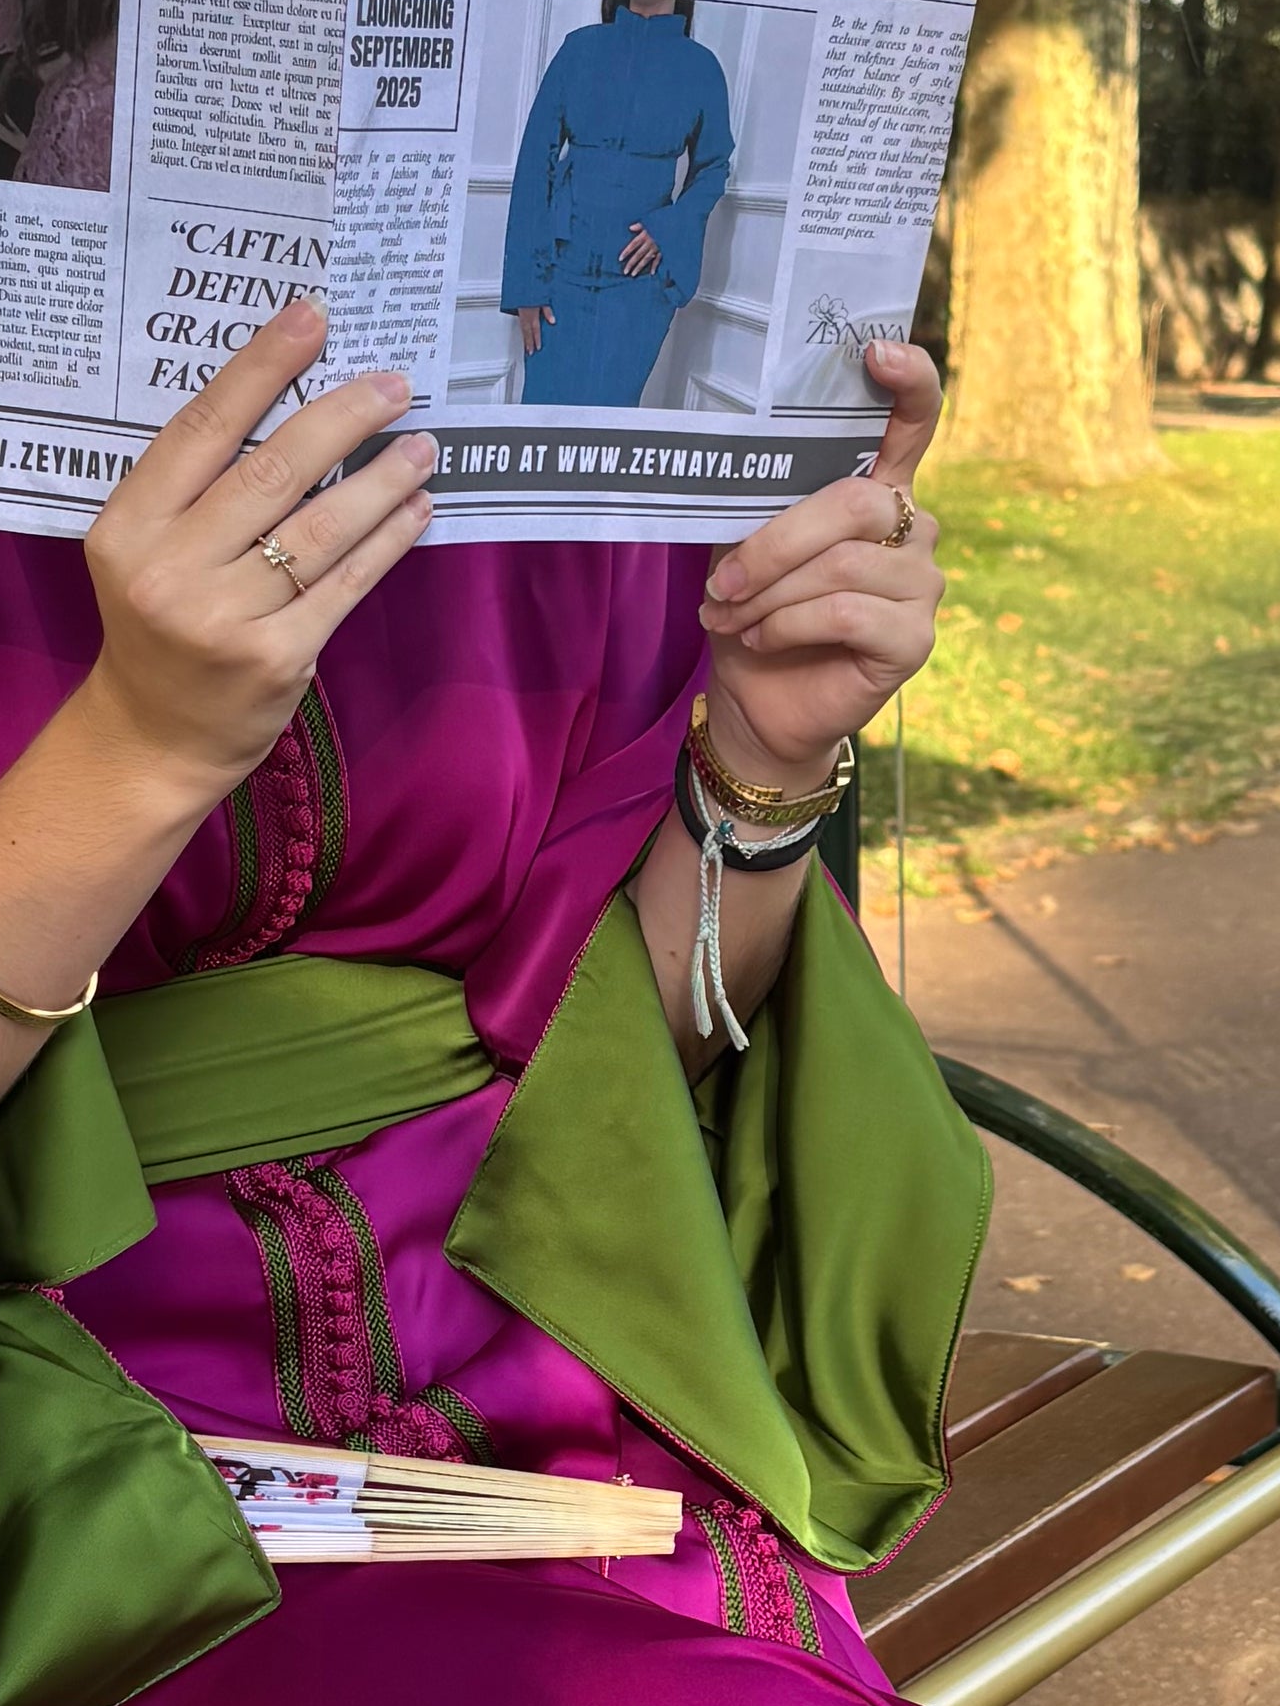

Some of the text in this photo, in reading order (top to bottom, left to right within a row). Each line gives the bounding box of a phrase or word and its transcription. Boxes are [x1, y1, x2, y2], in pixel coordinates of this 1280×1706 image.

[831, 15, 845, 28] Be
[851, 16, 868, 30] the
[900, 23, 910, 36] to
[350, 35, 454, 69] SEPTEMBER
[375, 76, 422, 108] 2025
[15, 214, 43, 228] amet,
[51, 216, 109, 234] consectetur
[18, 230, 61, 244] eiusmod
[71, 235, 108, 250] tempor
[170, 219, 334, 270] “CAFTAN
[34, 249, 68, 263] magna
[71, 251, 106, 266] aliqua.
[146, 311, 264, 352] GRAC
[806, 319, 906, 345] ZEYNAYA
[460, 445, 510, 474] INFO
[519, 445, 548, 474] AT
[557, 445, 794, 481] WWW.ZEYNAYA.COM
